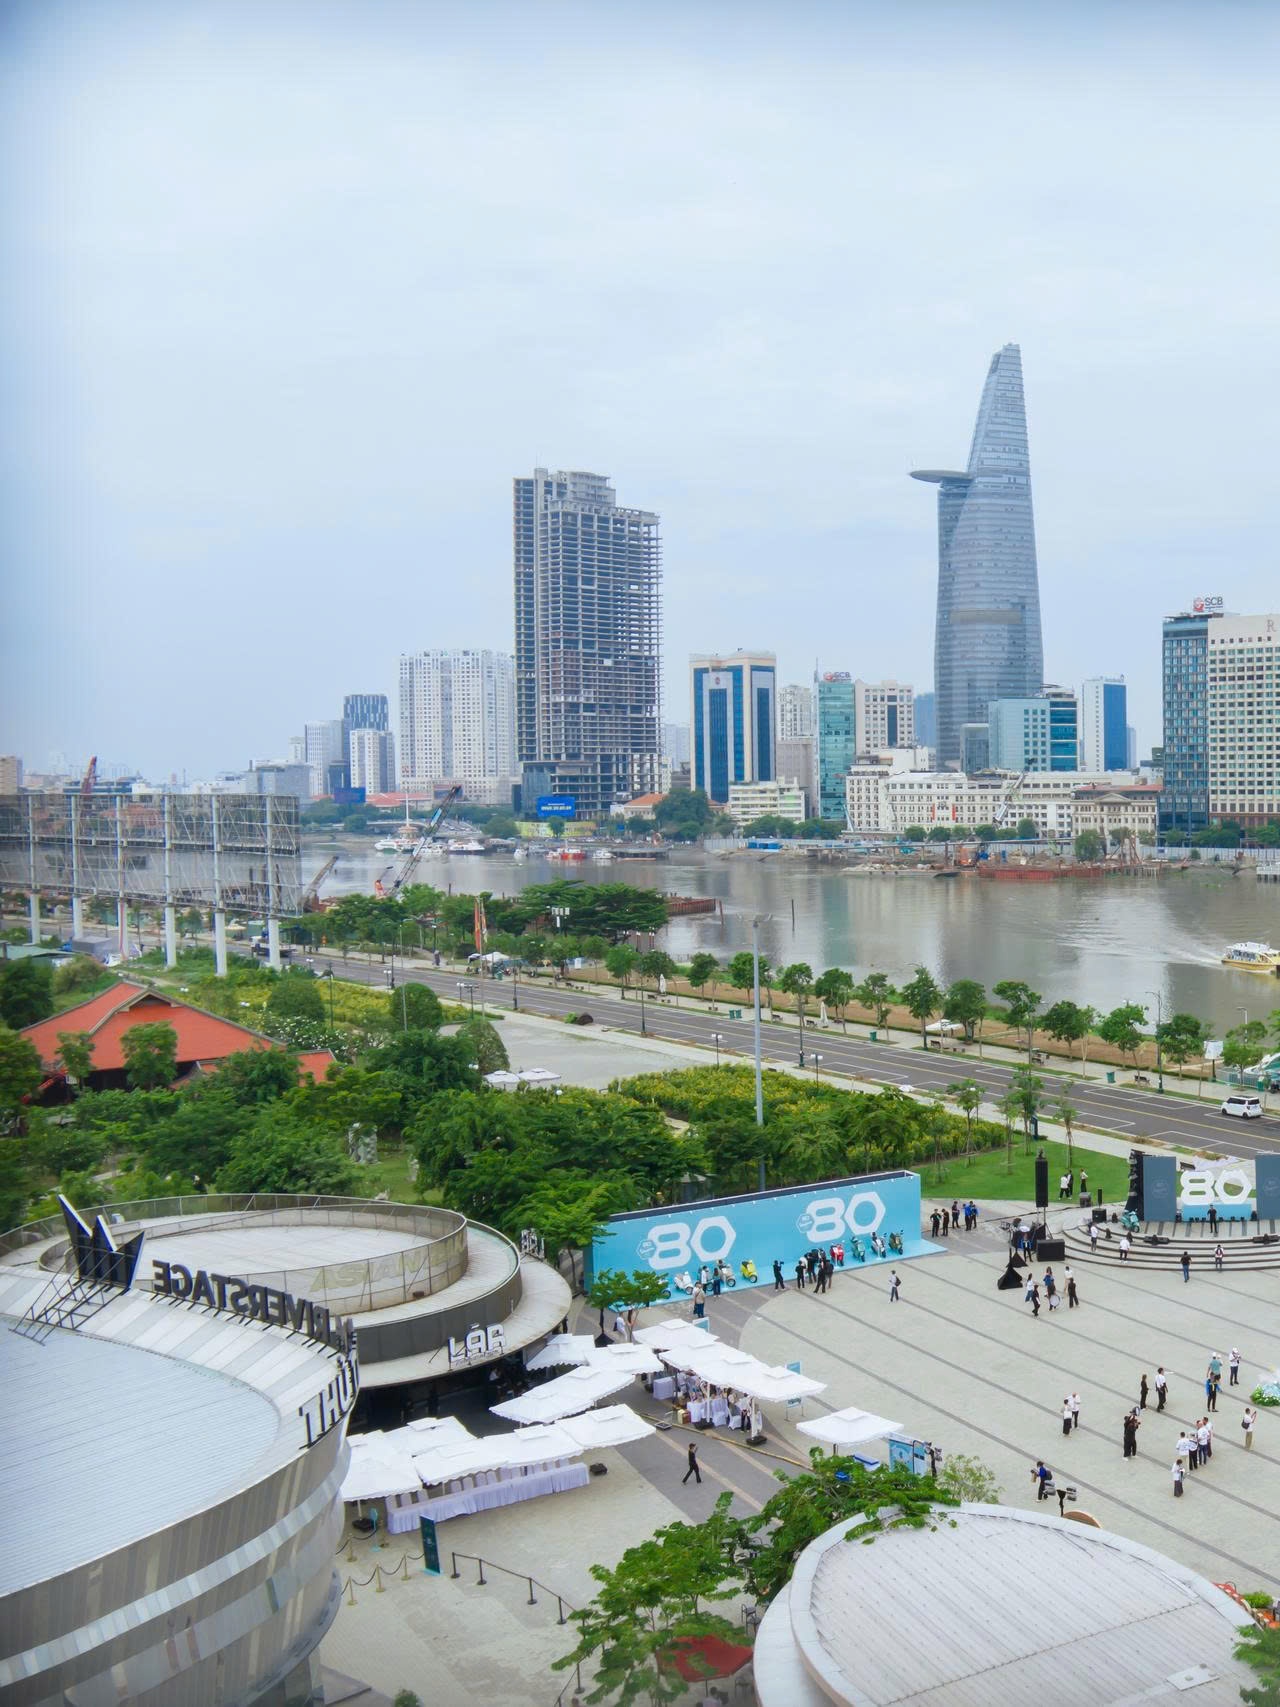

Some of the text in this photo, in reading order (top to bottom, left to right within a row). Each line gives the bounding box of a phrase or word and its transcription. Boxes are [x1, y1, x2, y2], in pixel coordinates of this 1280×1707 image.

[1204, 597, 1223, 606] SCB
[1180, 1169, 1252, 1205] 80
[806, 1191, 886, 1243] 80
[647, 1215, 737, 1270] 80
